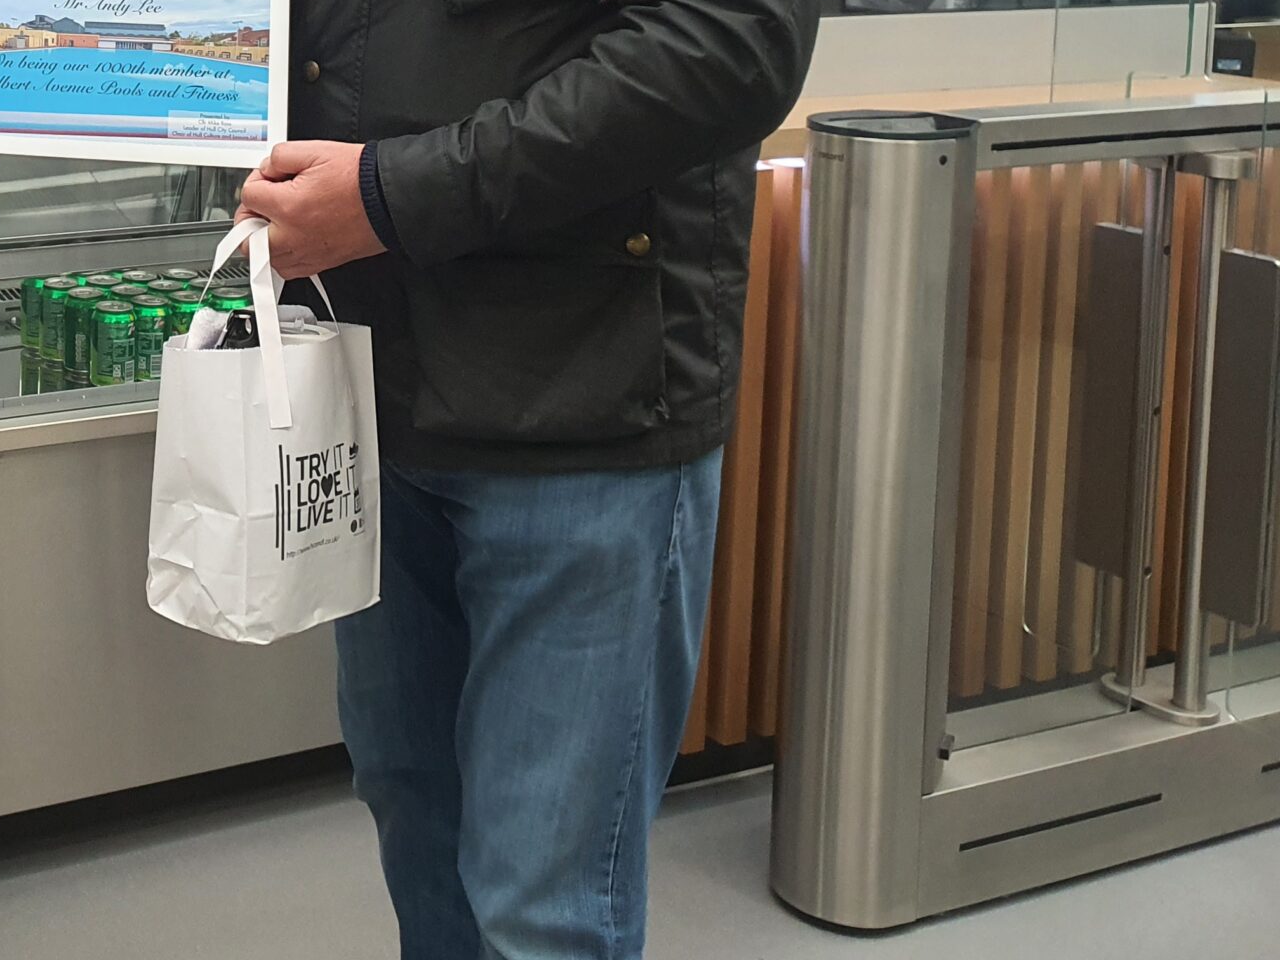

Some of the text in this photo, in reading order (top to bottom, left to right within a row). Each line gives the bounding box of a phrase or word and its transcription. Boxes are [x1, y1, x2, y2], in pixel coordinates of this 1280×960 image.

[132, 0, 163, 15] Lee
[18, 55, 58, 76] being
[63, 62, 89, 72] our
[94, 60, 145, 75] 1000th
[148, 63, 211, 78] member
[214, 69, 231, 79] at
[33, 77, 94, 94] Avenue
[97, 80, 143, 96] Pools
[148, 84, 181, 99] and
[182, 85, 239, 101] Fitness
[295, 443, 344, 481] TRY IT
[346, 464, 356, 492] IT
[297, 492, 351, 533] LIVE IT
